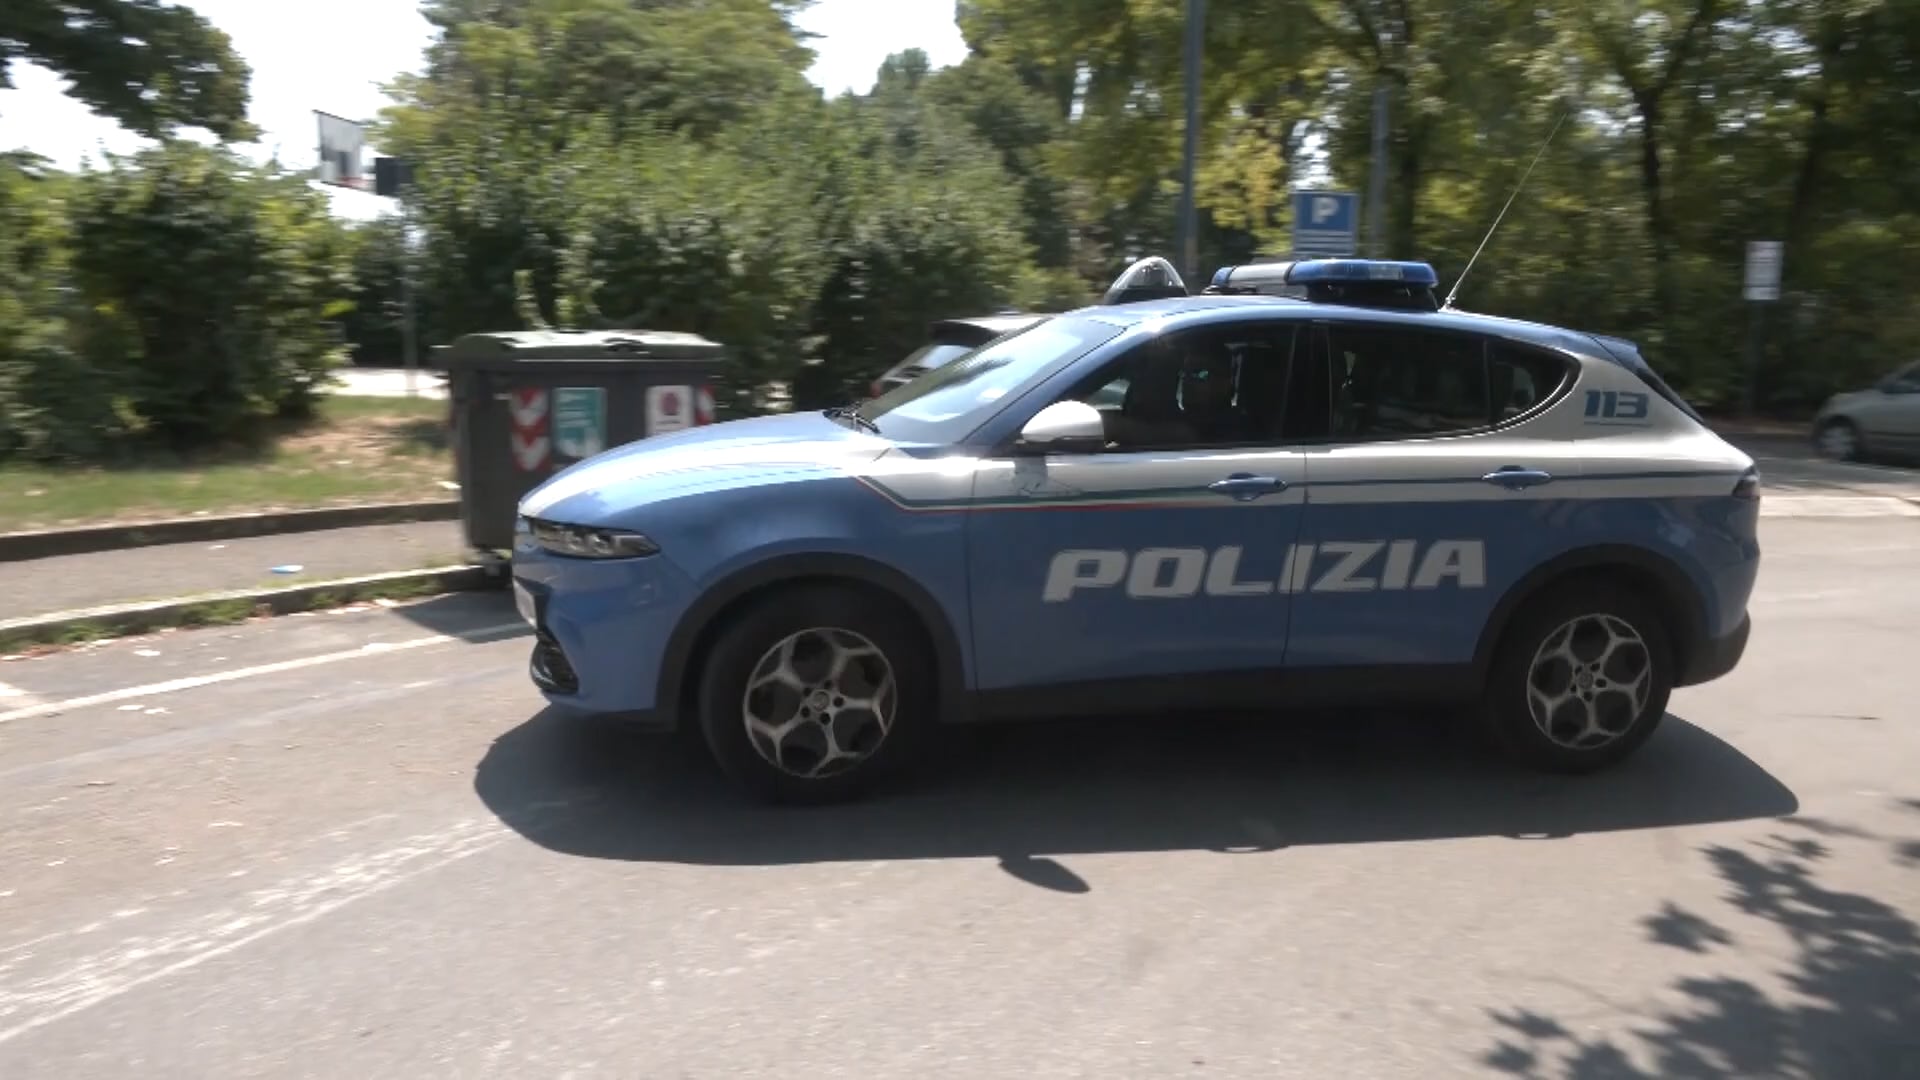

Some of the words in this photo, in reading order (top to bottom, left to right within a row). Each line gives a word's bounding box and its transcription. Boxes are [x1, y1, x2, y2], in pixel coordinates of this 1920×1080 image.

[1312, 197, 1338, 224] P
[1584, 390, 1649, 418] 113
[1042, 538, 1487, 602] POLIZIA
